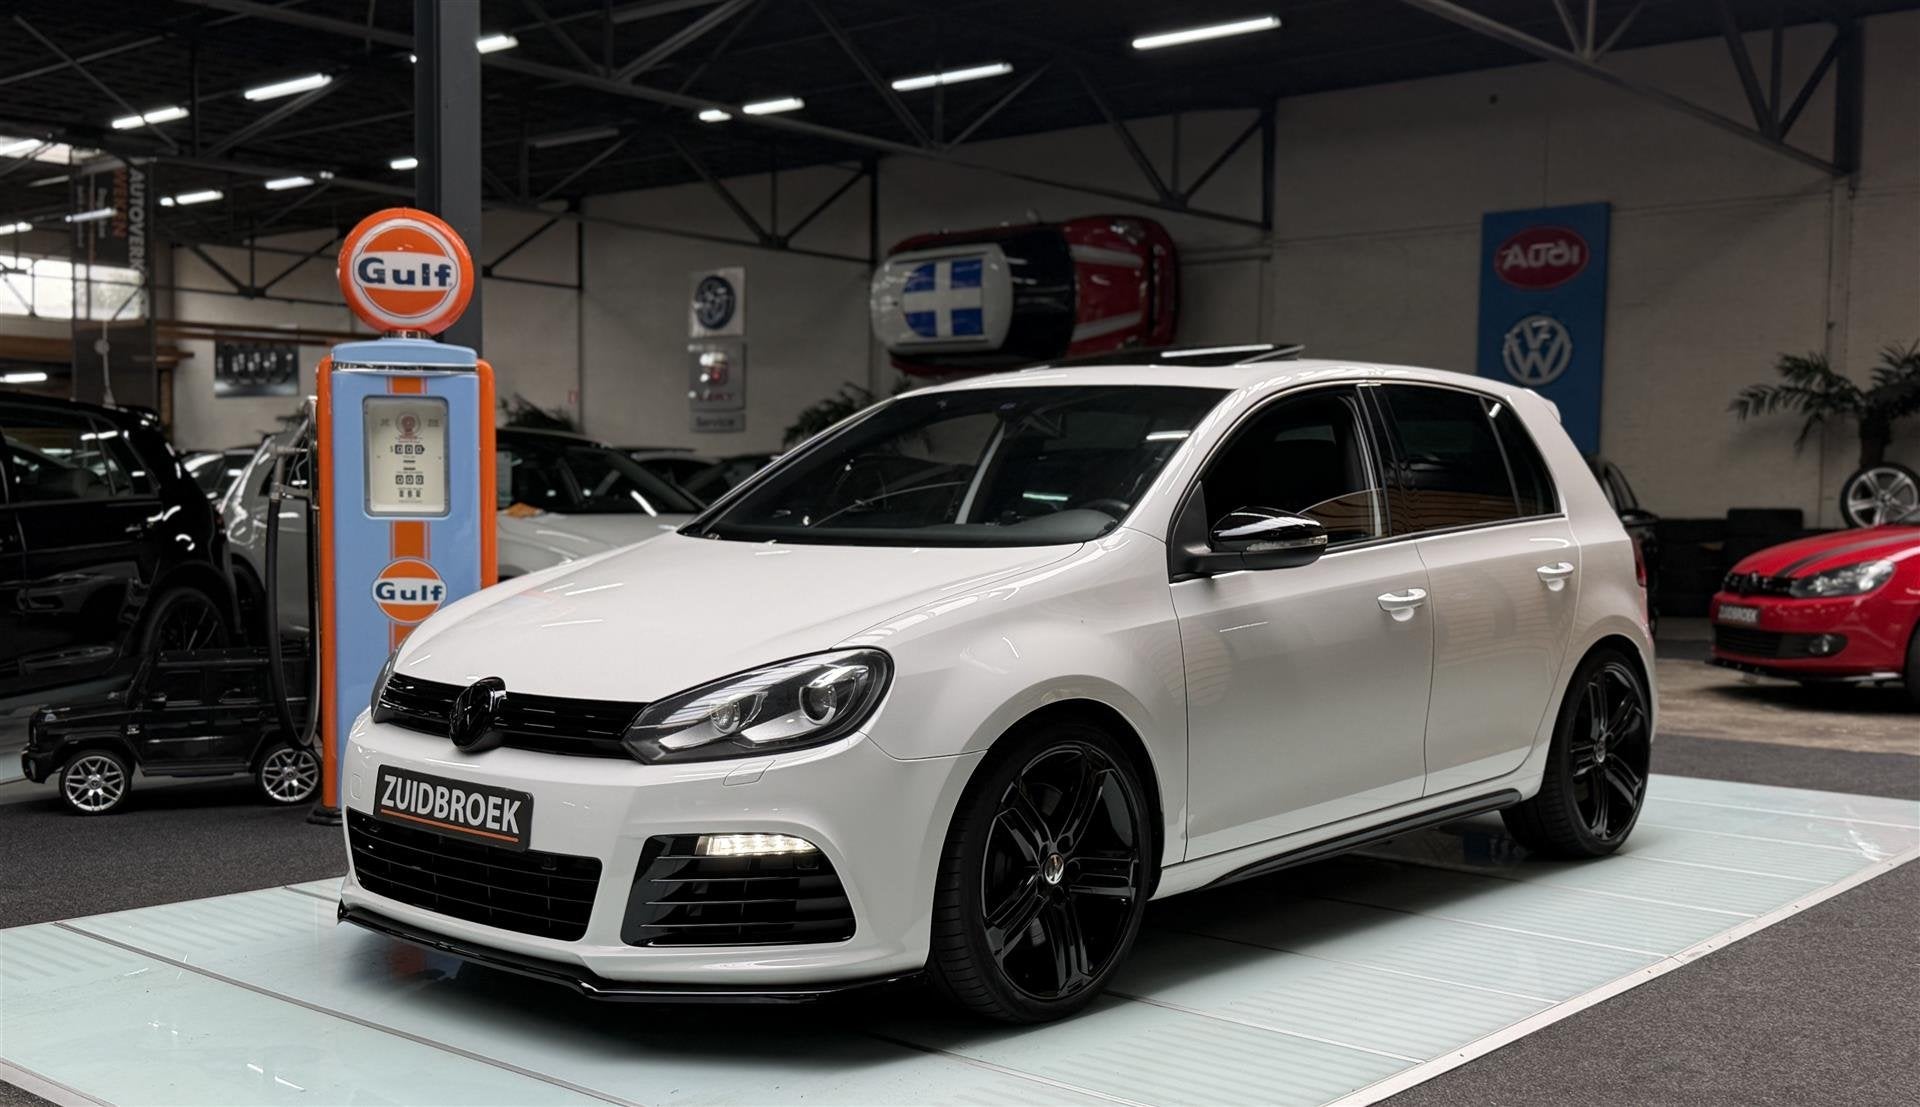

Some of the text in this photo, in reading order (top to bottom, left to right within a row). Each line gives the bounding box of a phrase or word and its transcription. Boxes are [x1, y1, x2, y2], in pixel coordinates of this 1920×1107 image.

[357, 257, 452, 287] Gulf
[375, 582, 443, 601] Gulf
[381, 774, 522, 834] ZUIDBROEK
